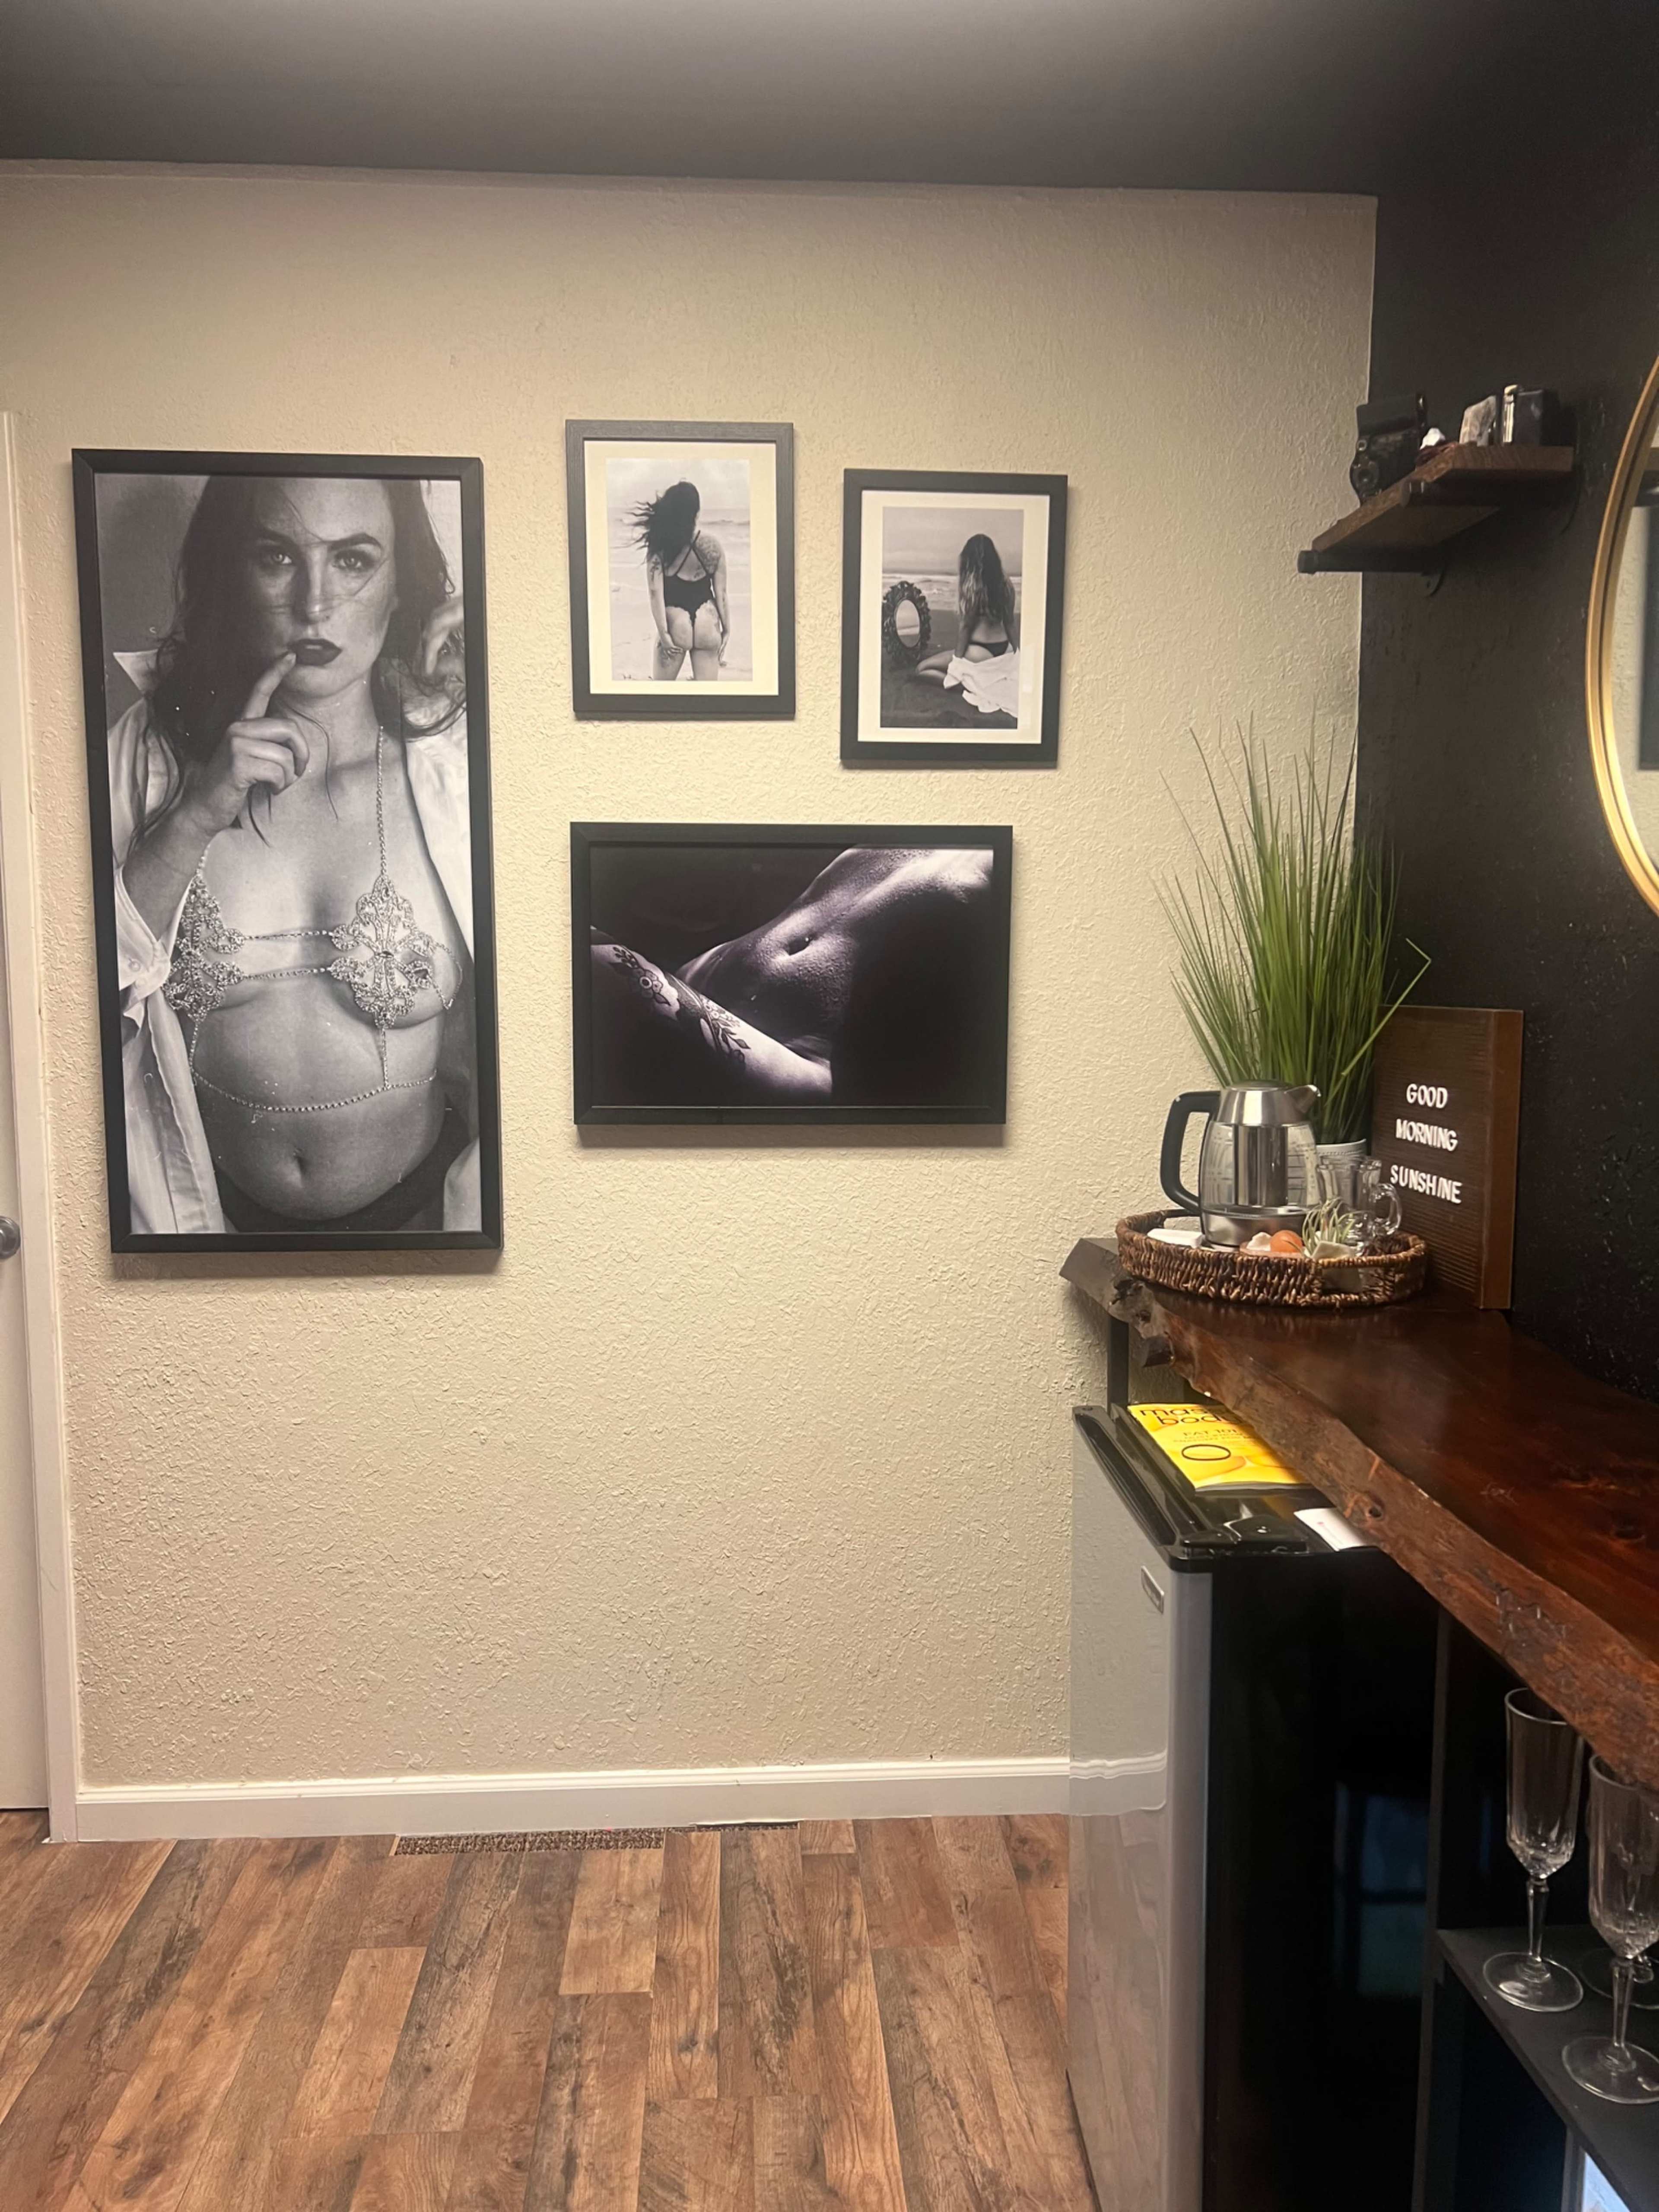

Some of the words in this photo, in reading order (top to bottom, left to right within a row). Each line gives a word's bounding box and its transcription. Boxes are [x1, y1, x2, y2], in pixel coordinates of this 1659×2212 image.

[1406, 1083, 1448, 1109] GOOD
[1395, 1118, 1458, 1151] MORNING
[1390, 1165, 1463, 1204] SUNSHINE
